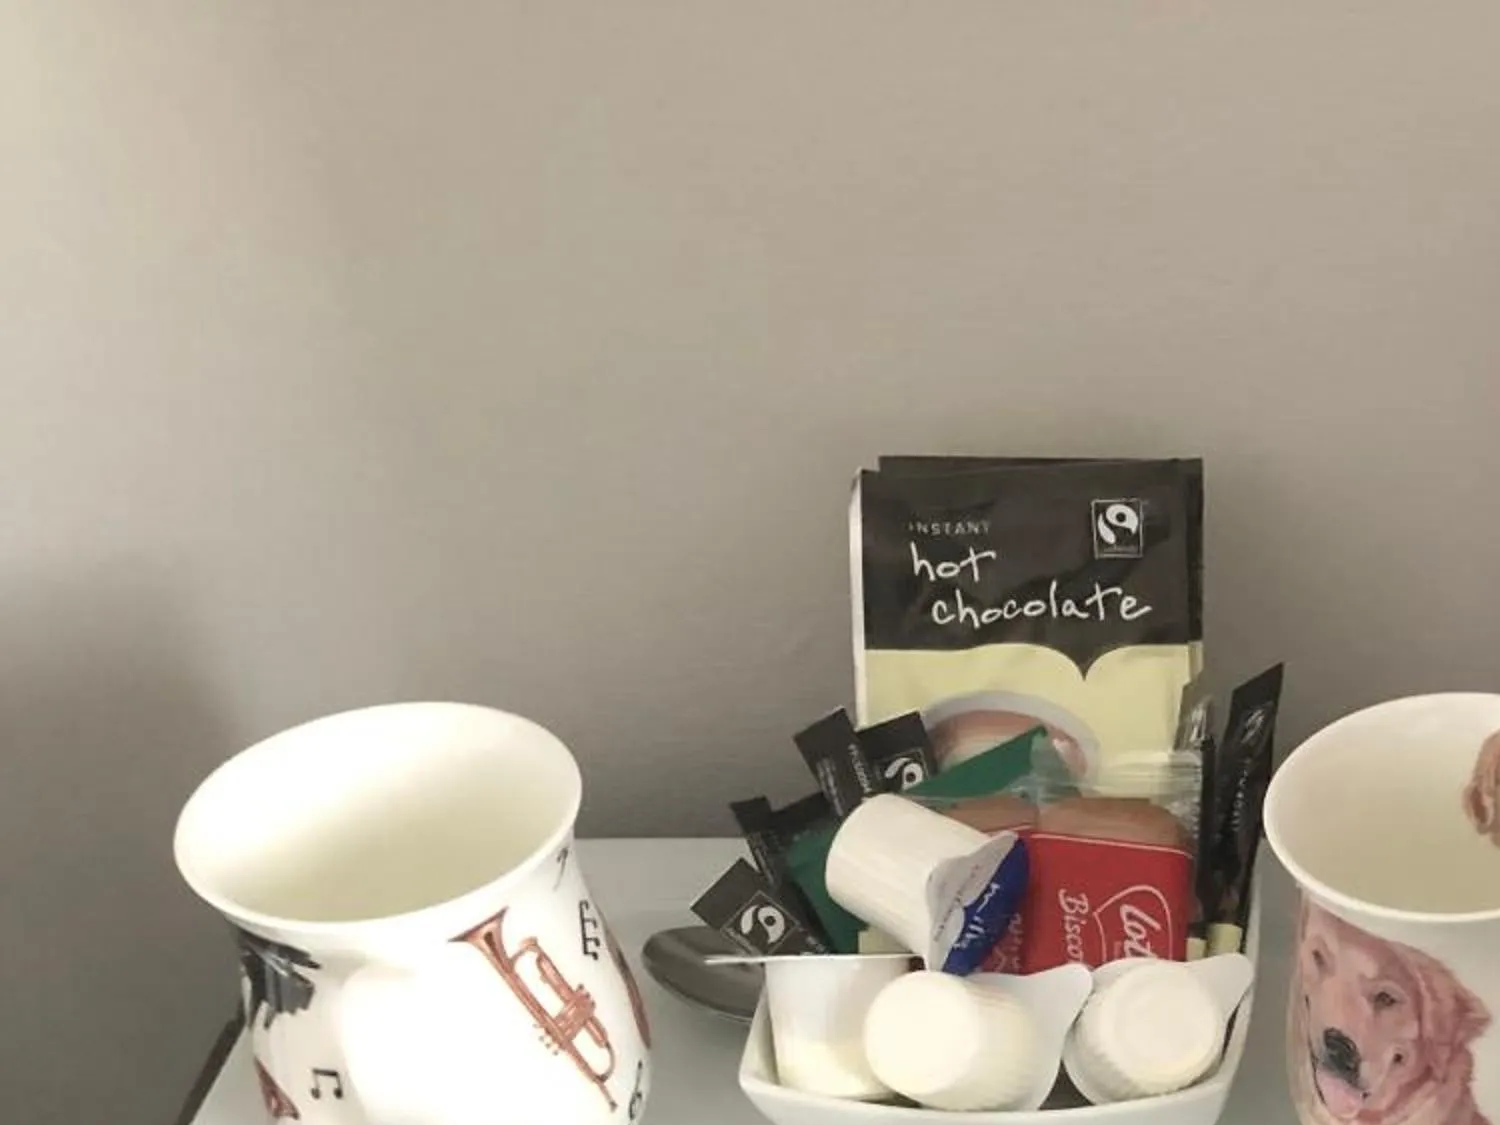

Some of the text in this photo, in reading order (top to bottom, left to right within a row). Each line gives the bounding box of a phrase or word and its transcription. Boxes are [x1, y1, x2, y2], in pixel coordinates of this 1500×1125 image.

[908, 519, 991, 537] INSTANT
[910, 541, 997, 583] hot
[931, 580, 1153, 630] chocolate
[1058, 887, 1089, 962] Bisco
[1119, 903, 1162, 958] Lot
